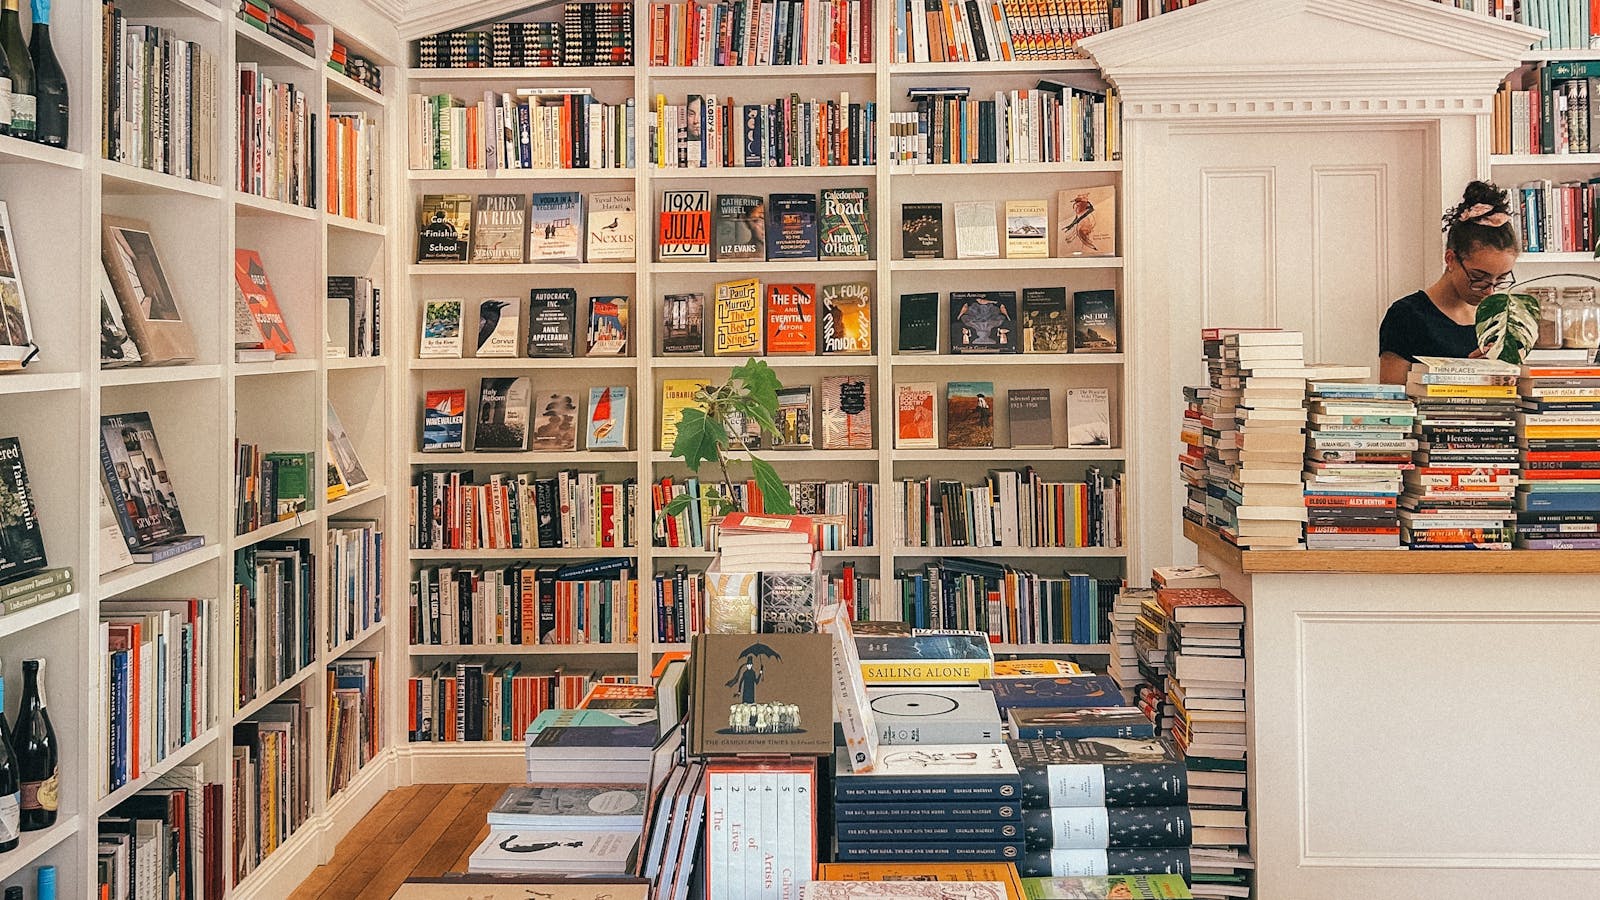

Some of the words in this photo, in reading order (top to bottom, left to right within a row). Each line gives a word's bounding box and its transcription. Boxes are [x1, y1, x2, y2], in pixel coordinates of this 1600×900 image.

[706, 98, 714, 128] GLORY
[486, 196, 517, 210] PARIS
[721, 198, 760, 207] CATHERINE
[825, 200, 864, 215] Road
[721, 206, 746, 215] WHEEL
[478, 211, 490, 225] IN
[491, 210, 524, 225] RUINS
[664, 214, 705, 239] JULIA
[591, 231, 634, 243] Nexus
[828, 233, 862, 243] Andrew
[429, 243, 457, 251] School
[721, 245, 733, 253] LIZ
[733, 244, 756, 253] EVANS
[730, 288, 747, 299] Paul
[771, 294, 790, 305] THE
[792, 294, 811, 305] END
[725, 299, 751, 311] Murray
[108, 417, 125, 428] THE
[12, 461, 34, 530] Tasmania
[136, 514, 161, 530] SPACES
[523, 592, 533, 631] CONFLICT
[764, 611, 815, 623] FRANCE
[868, 667, 922, 678] SAILING
[926, 667, 971, 678] ALONE
[457, 716, 465, 734] WAVE
[714, 808, 724, 831] The
[732, 823, 741, 852] Lives
[749, 838, 758, 850] of
[765, 852, 774, 889] Artists
